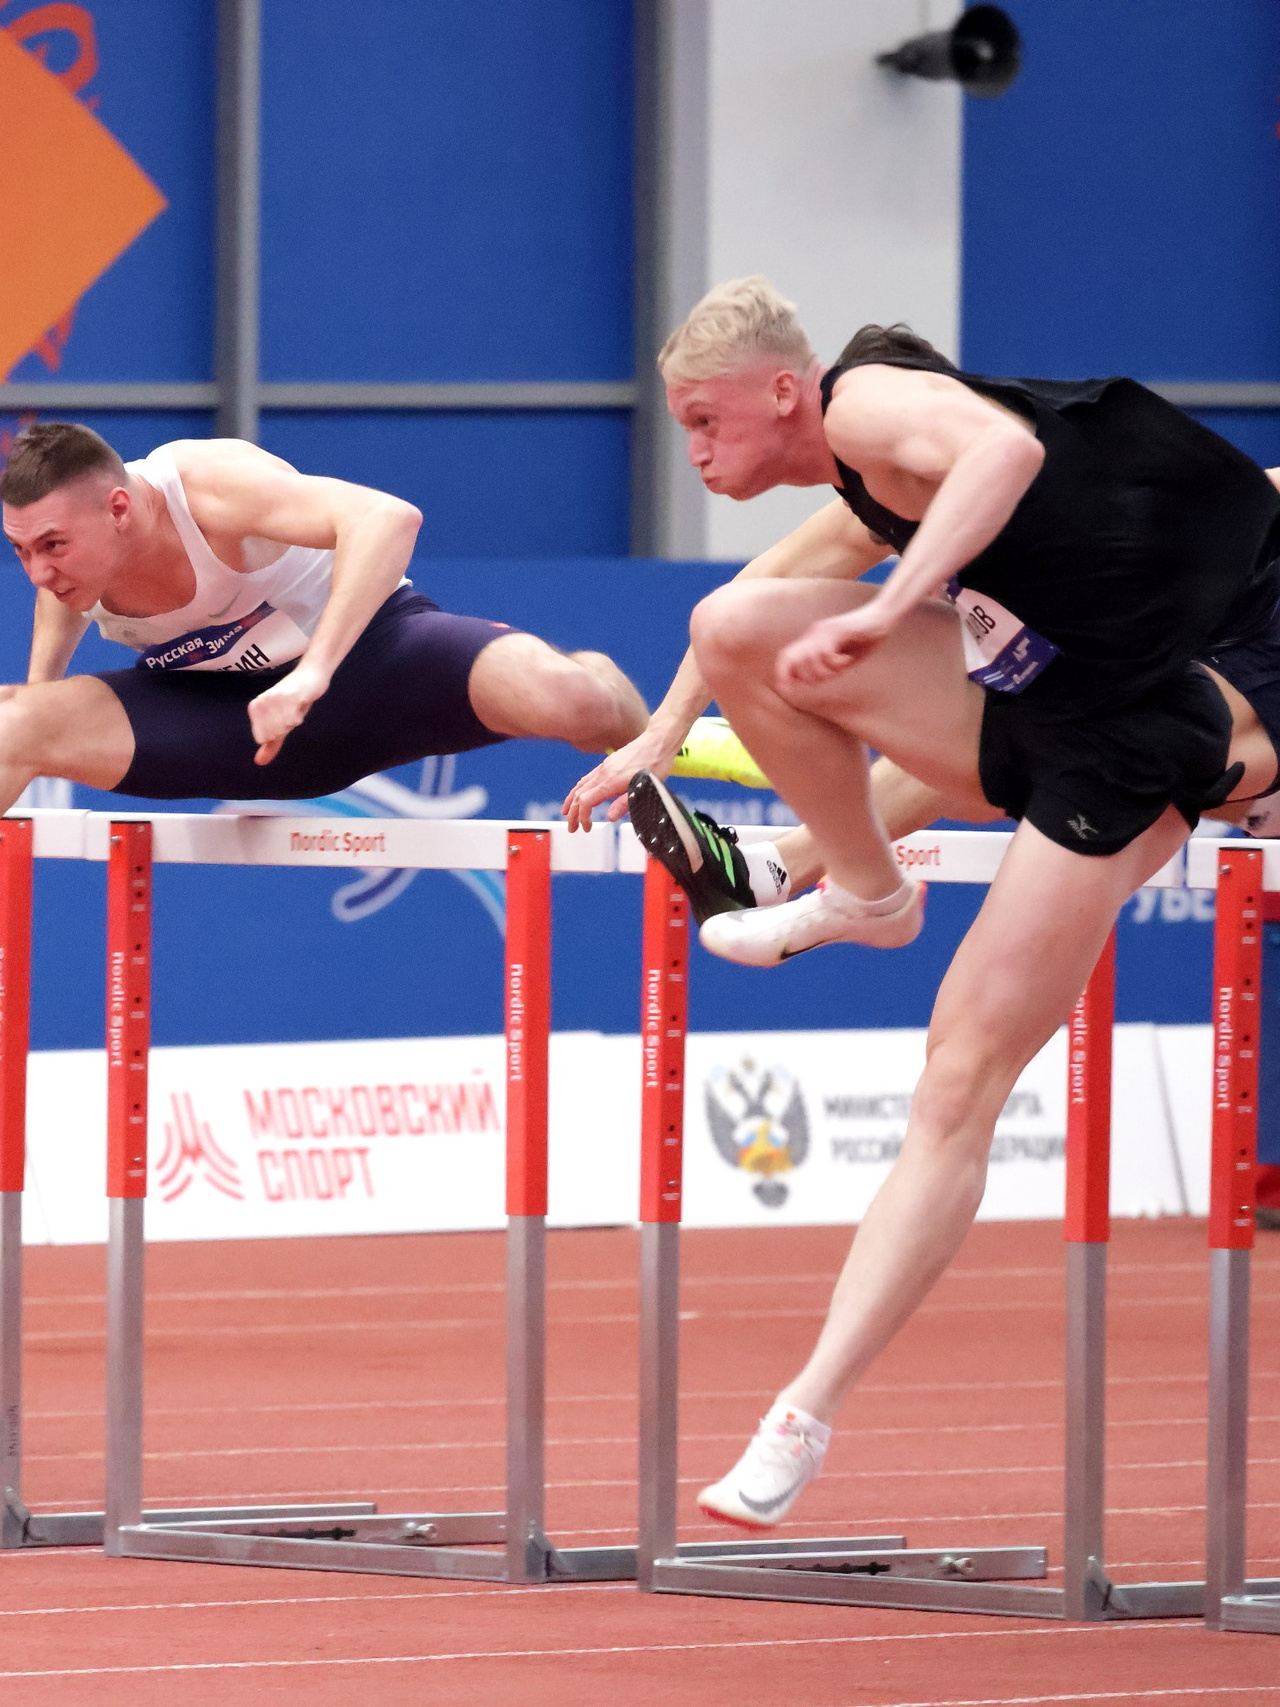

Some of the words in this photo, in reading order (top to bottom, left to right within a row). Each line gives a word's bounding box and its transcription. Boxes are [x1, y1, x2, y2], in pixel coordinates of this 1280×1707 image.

[145, 637, 205, 669] Русская
[205, 625, 243, 654] Зима
[343, 832, 385, 857] Sport
[896, 845, 941, 871] Sport
[109, 1015, 124, 1066] Sport
[1073, 988, 1088, 1046] ordic
[508, 1028, 523, 1080] Sport
[644, 1035, 659, 1087] Sport
[1070, 1049, 1086, 1103] Sport
[243, 1068, 501, 1140] МОСКОВСКИЙ
[1215, 1054, 1231, 1109] Sport
[257, 1146, 375, 1201] СПОРТ
